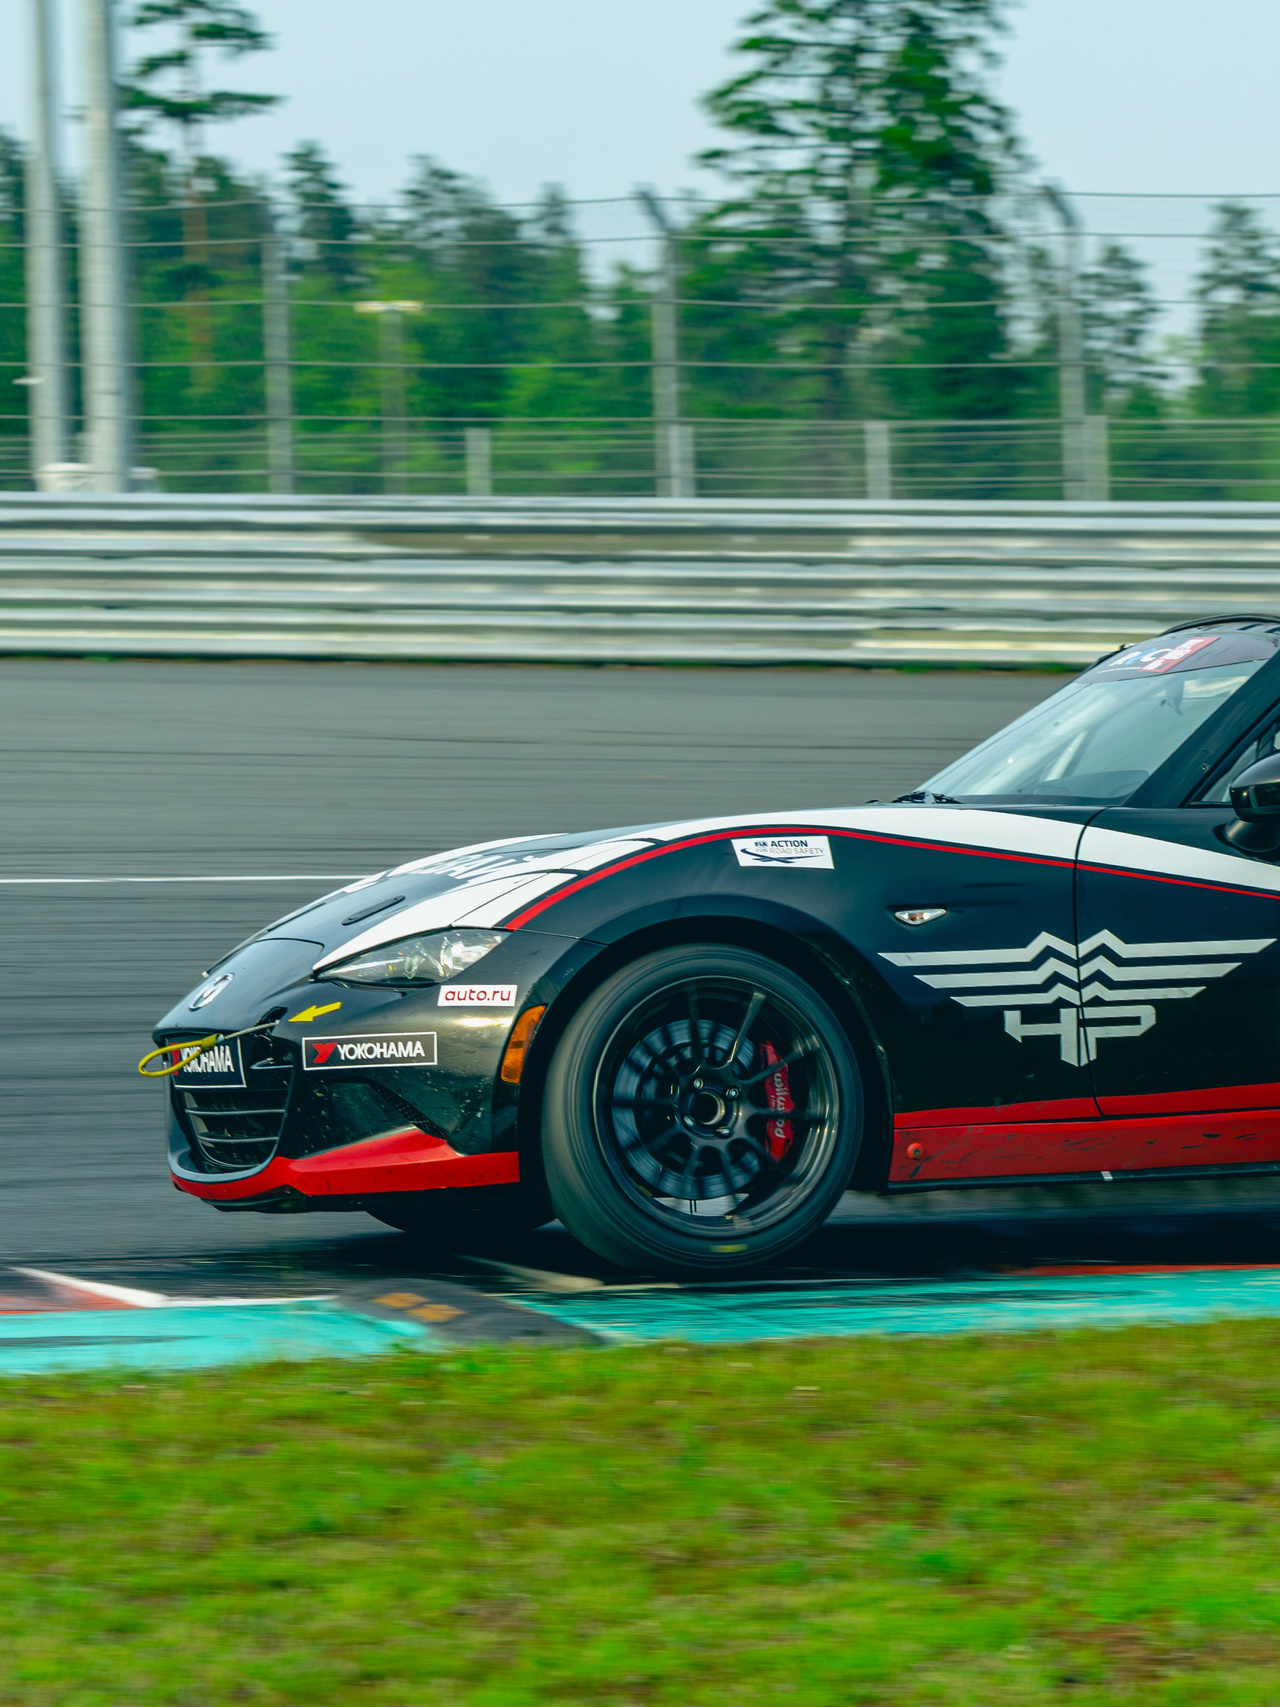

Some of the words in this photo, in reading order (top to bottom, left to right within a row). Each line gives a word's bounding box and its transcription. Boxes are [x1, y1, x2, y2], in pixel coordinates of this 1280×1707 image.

[444, 989, 511, 1001] auto.ru
[336, 1040, 425, 1060] YOKOHAMA
[773, 1072, 788, 1139] wilwod
